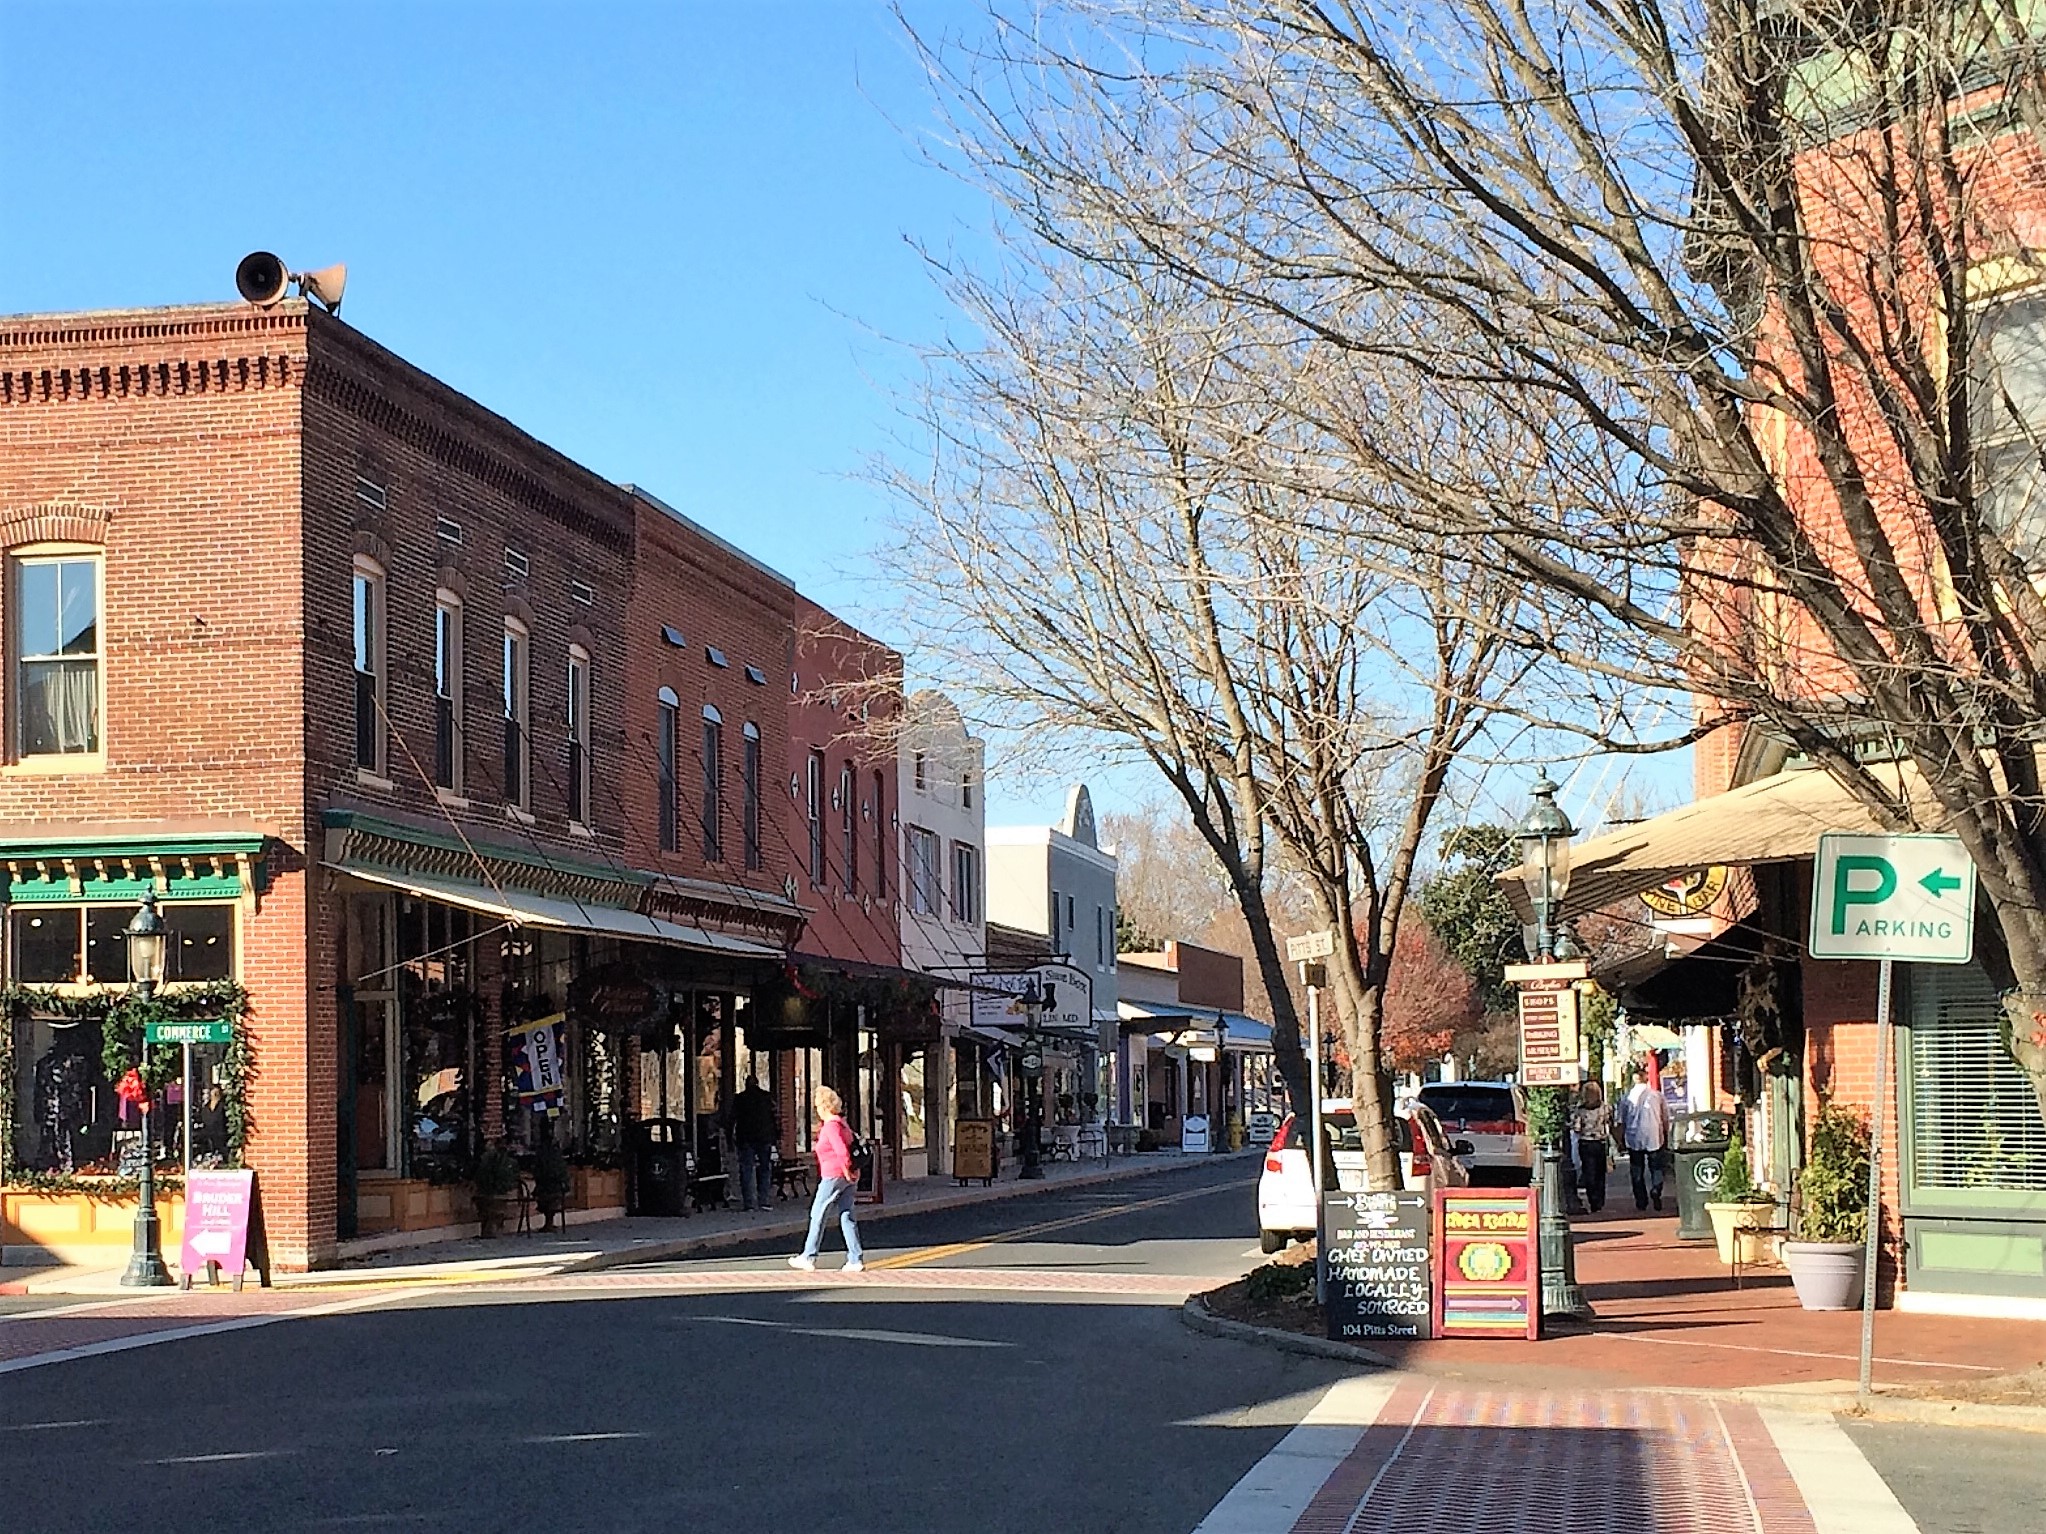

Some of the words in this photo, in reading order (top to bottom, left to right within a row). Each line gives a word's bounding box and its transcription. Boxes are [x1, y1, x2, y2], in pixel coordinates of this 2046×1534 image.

[1692, 881, 1720, 907] BAR
[156, 1025, 212, 1041] COMMERCE
[533, 1031, 553, 1087] OPEN
[202, 1204, 231, 1217] HILL
[1327, 1247, 1370, 1264] CHEF
[1372, 1247, 1430, 1263] OWNED
[1326, 1266, 1421, 1282] HANDMADE
[1356, 1298, 1430, 1316] SOURCED
[1342, 1324, 1362, 1336] 104
[1363, 1323, 1387, 1336] Pitts
[1387, 1323, 1418, 1336] Street
